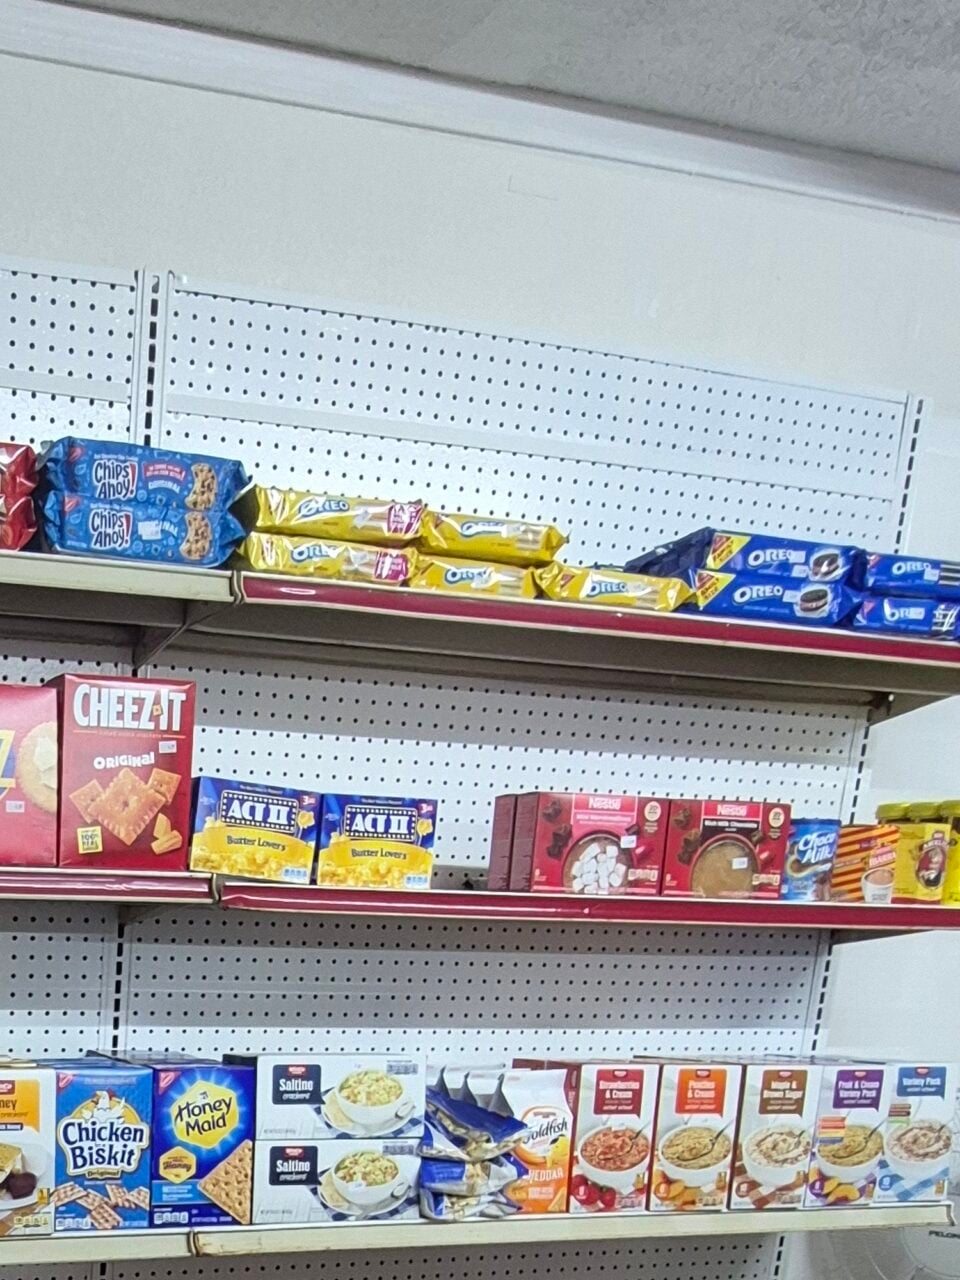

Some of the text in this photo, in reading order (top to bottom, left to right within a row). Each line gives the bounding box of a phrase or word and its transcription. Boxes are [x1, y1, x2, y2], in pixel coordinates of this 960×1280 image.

[94, 461, 130, 489] Chips
[98, 463, 137, 499] Ahoy!
[90, 511, 125, 538] Chips
[93, 513, 131, 548] Ahoy!
[733, 585, 783, 604] OREO
[227, 800, 290, 825] ACT II
[350, 813, 410, 834] ACT II
[279, 1078, 314, 1092] Saltine
[173, 1096, 233, 1122] Honey
[61, 1121, 144, 1145] Chicken
[185, 1114, 227, 1137] Maid
[68, 1145, 135, 1169] Biskit
[276, 1160, 311, 1173] Saltine
